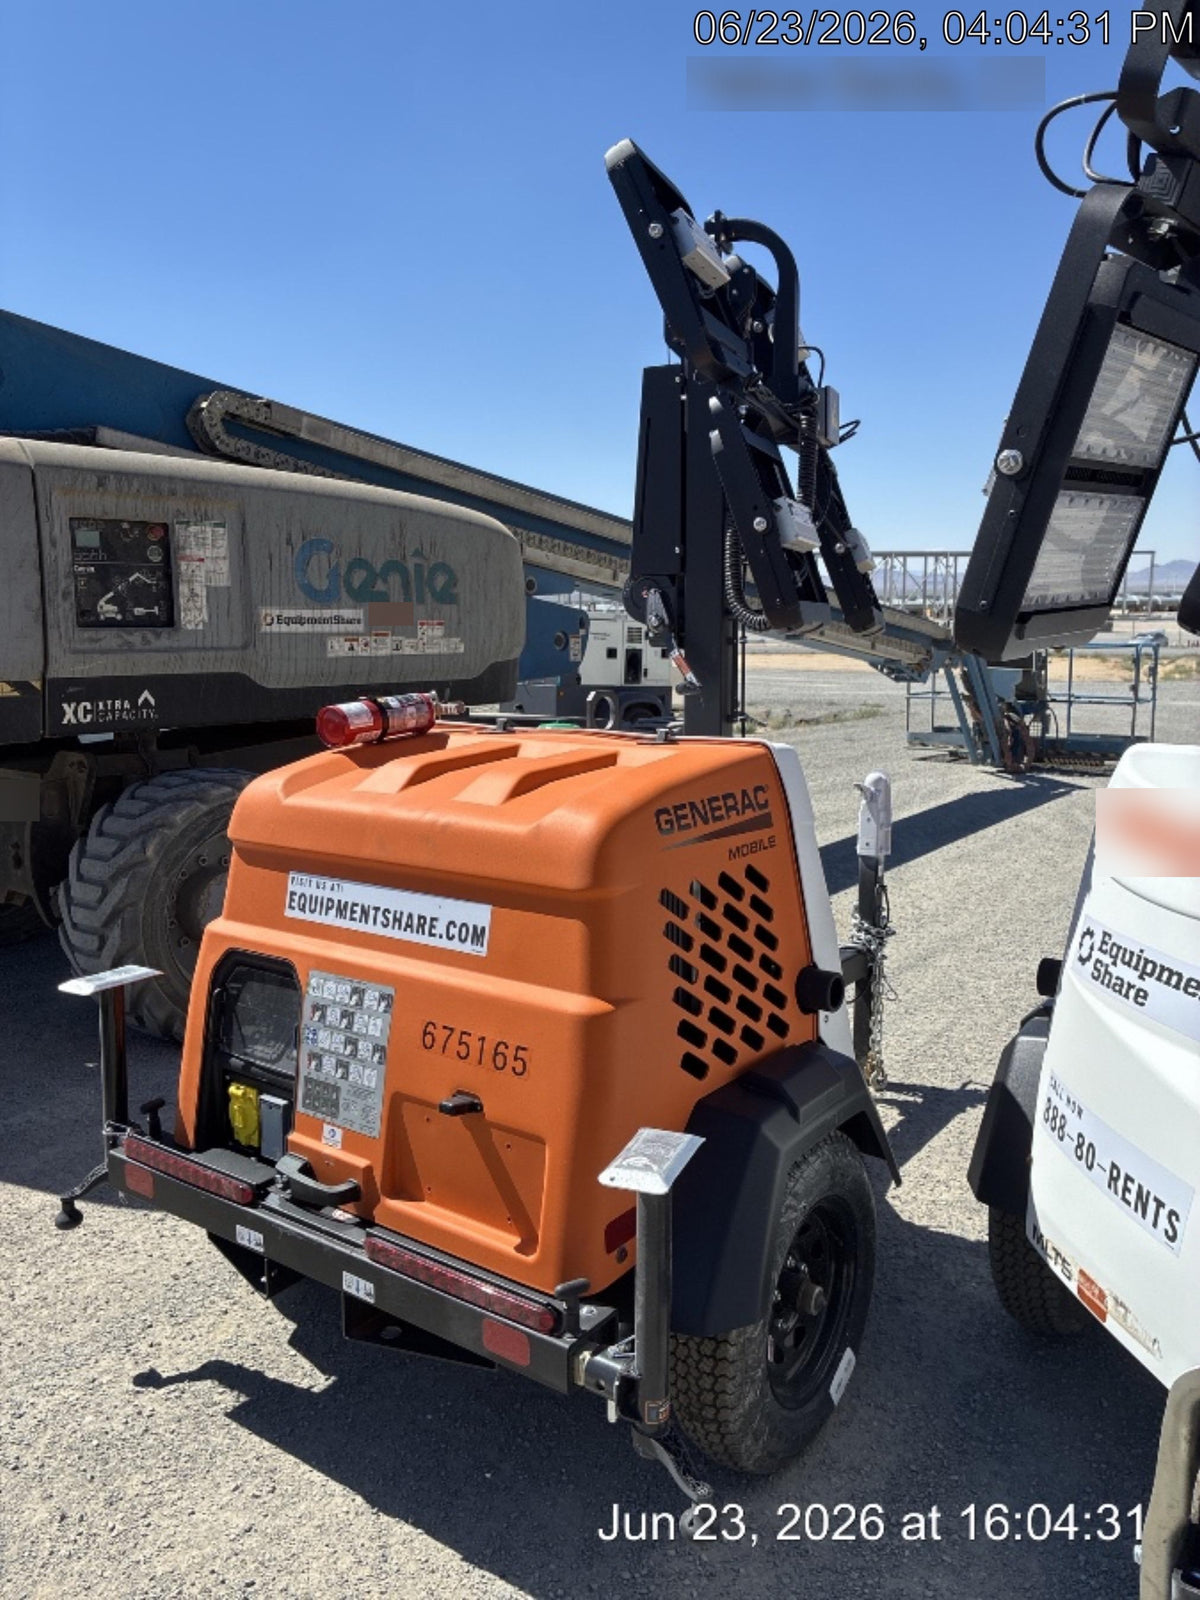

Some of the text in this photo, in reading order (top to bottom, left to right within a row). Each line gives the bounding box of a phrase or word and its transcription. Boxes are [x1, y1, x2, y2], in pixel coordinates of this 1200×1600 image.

[295, 536, 458, 605] Genie
[276, 614, 362, 626] EquipmentShare
[61, 701, 93, 725] XC
[98, 700, 131, 710] XTRA
[654, 785, 769, 836] GENERAC
[728, 835, 777, 861] MOBILE
[290, 876, 313, 889] VISIT
[315, 880, 327, 891] US
[287, 890, 487, 948] EQUIPMENTSHARE.COM
[1090, 958, 1149, 1007] Share
[1097, 930, 1200, 1000] Equipme
[422, 1020, 529, 1077] 675165
[1043, 1096, 1181, 1243] 888-80-RENTS
